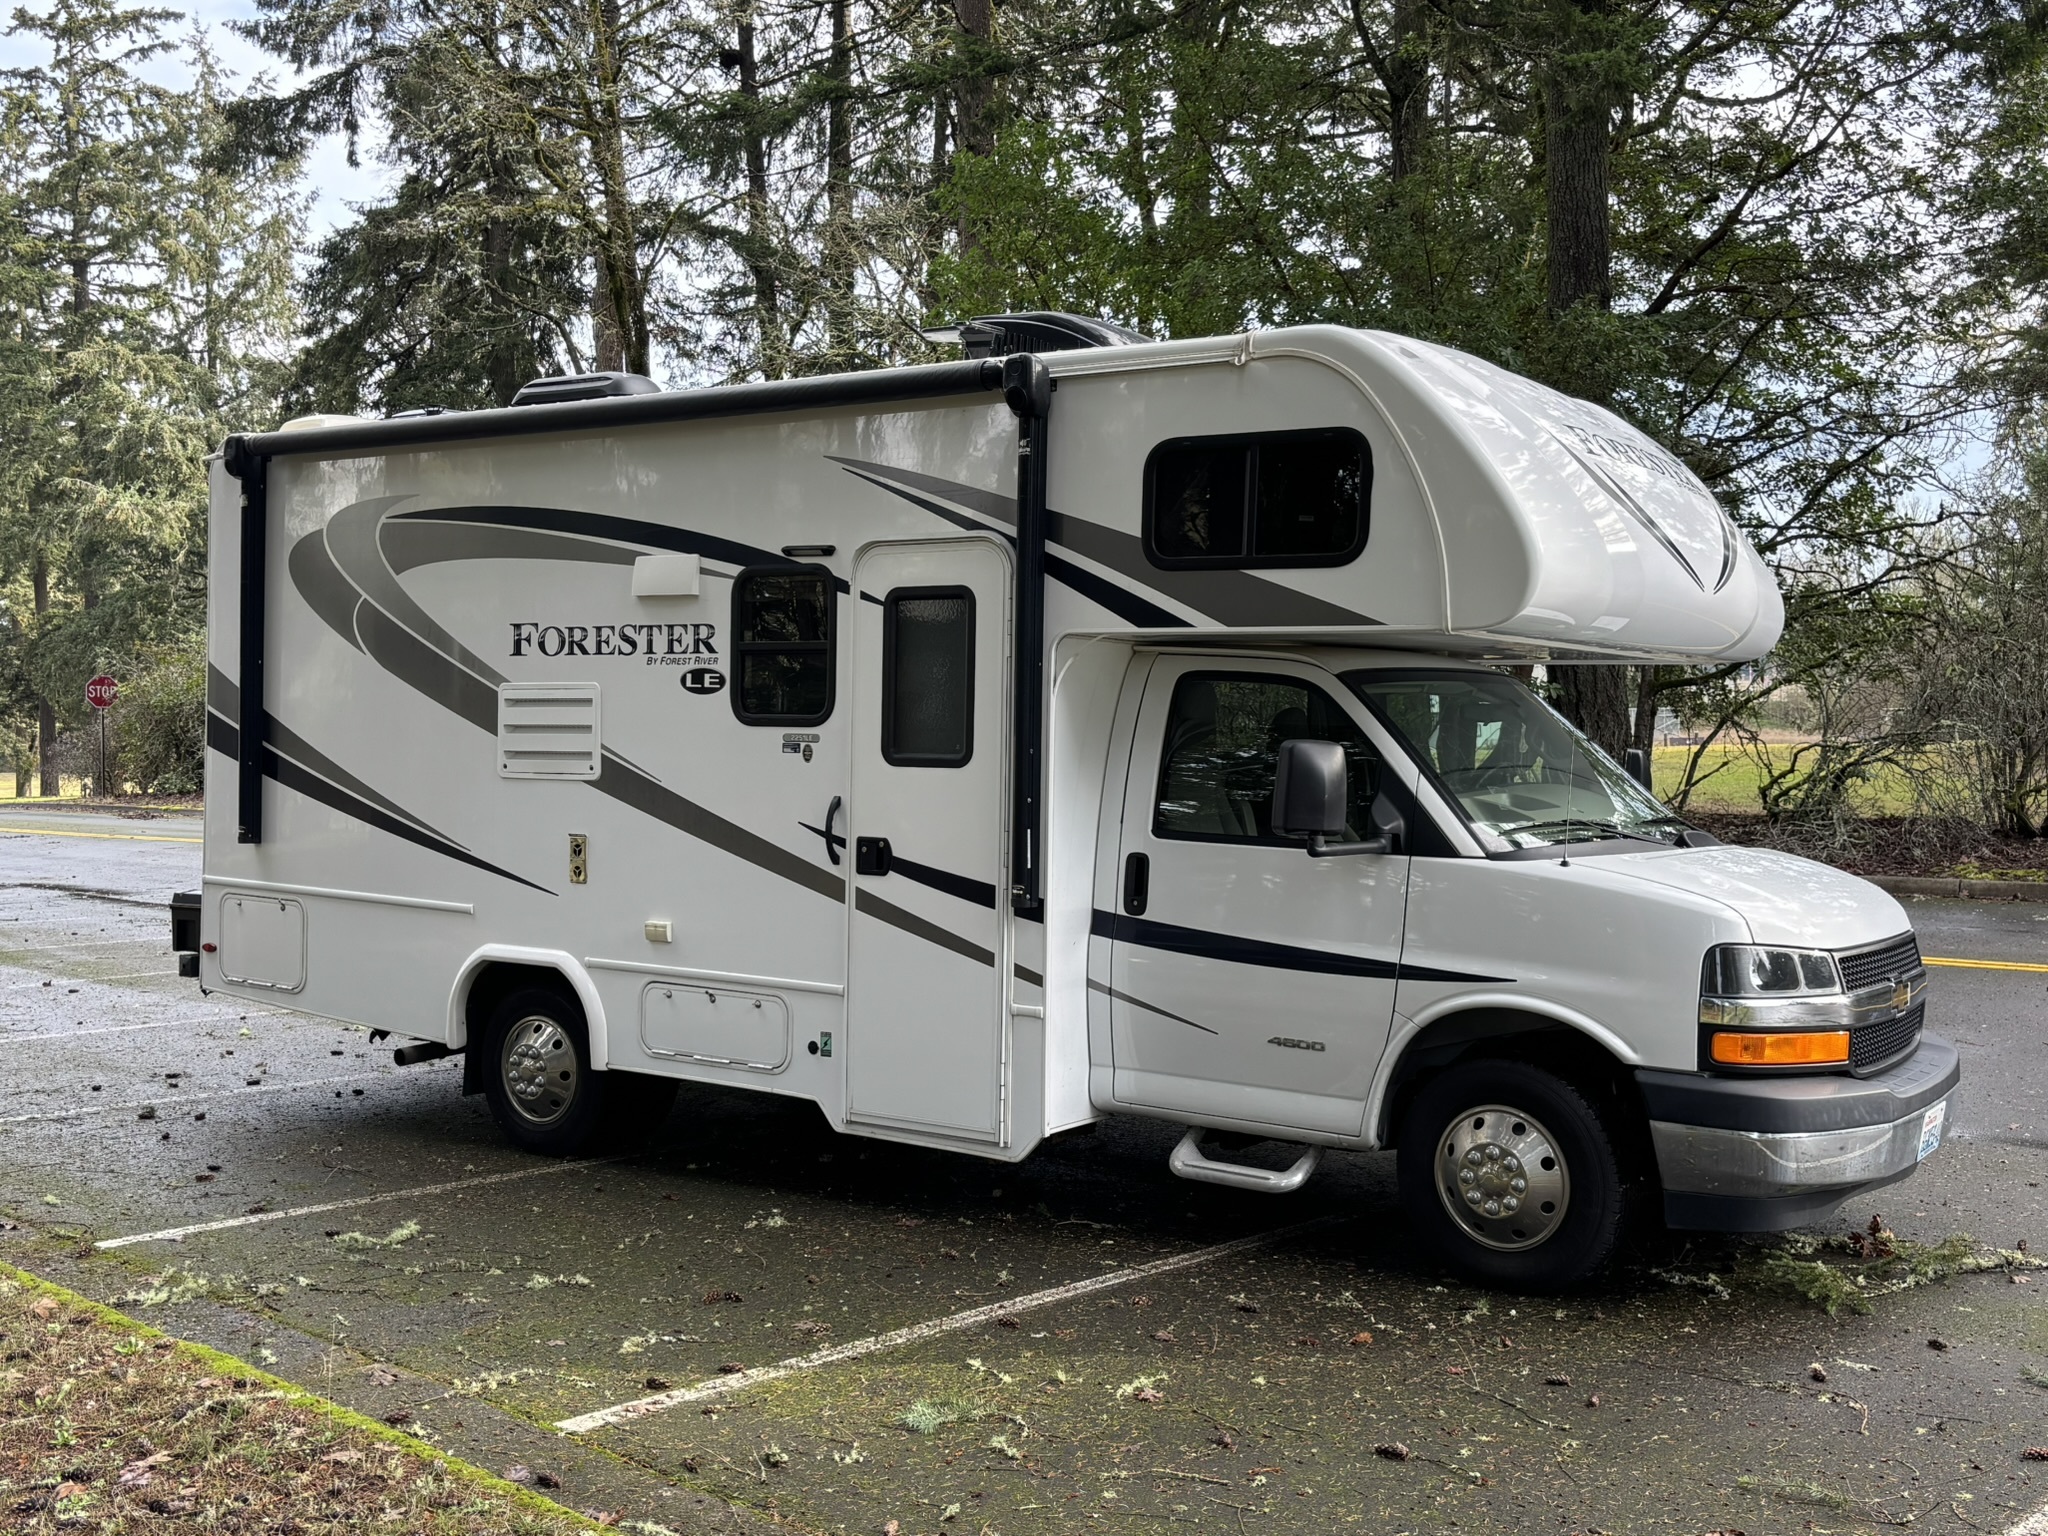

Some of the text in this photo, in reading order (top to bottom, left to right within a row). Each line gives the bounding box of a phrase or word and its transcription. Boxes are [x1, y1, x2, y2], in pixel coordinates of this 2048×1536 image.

[509, 622, 719, 656] FORESTER
[646, 655, 719, 666] BY FOREST RIVER
[685, 673, 721, 688] LE
[88, 685, 117, 698] STOP
